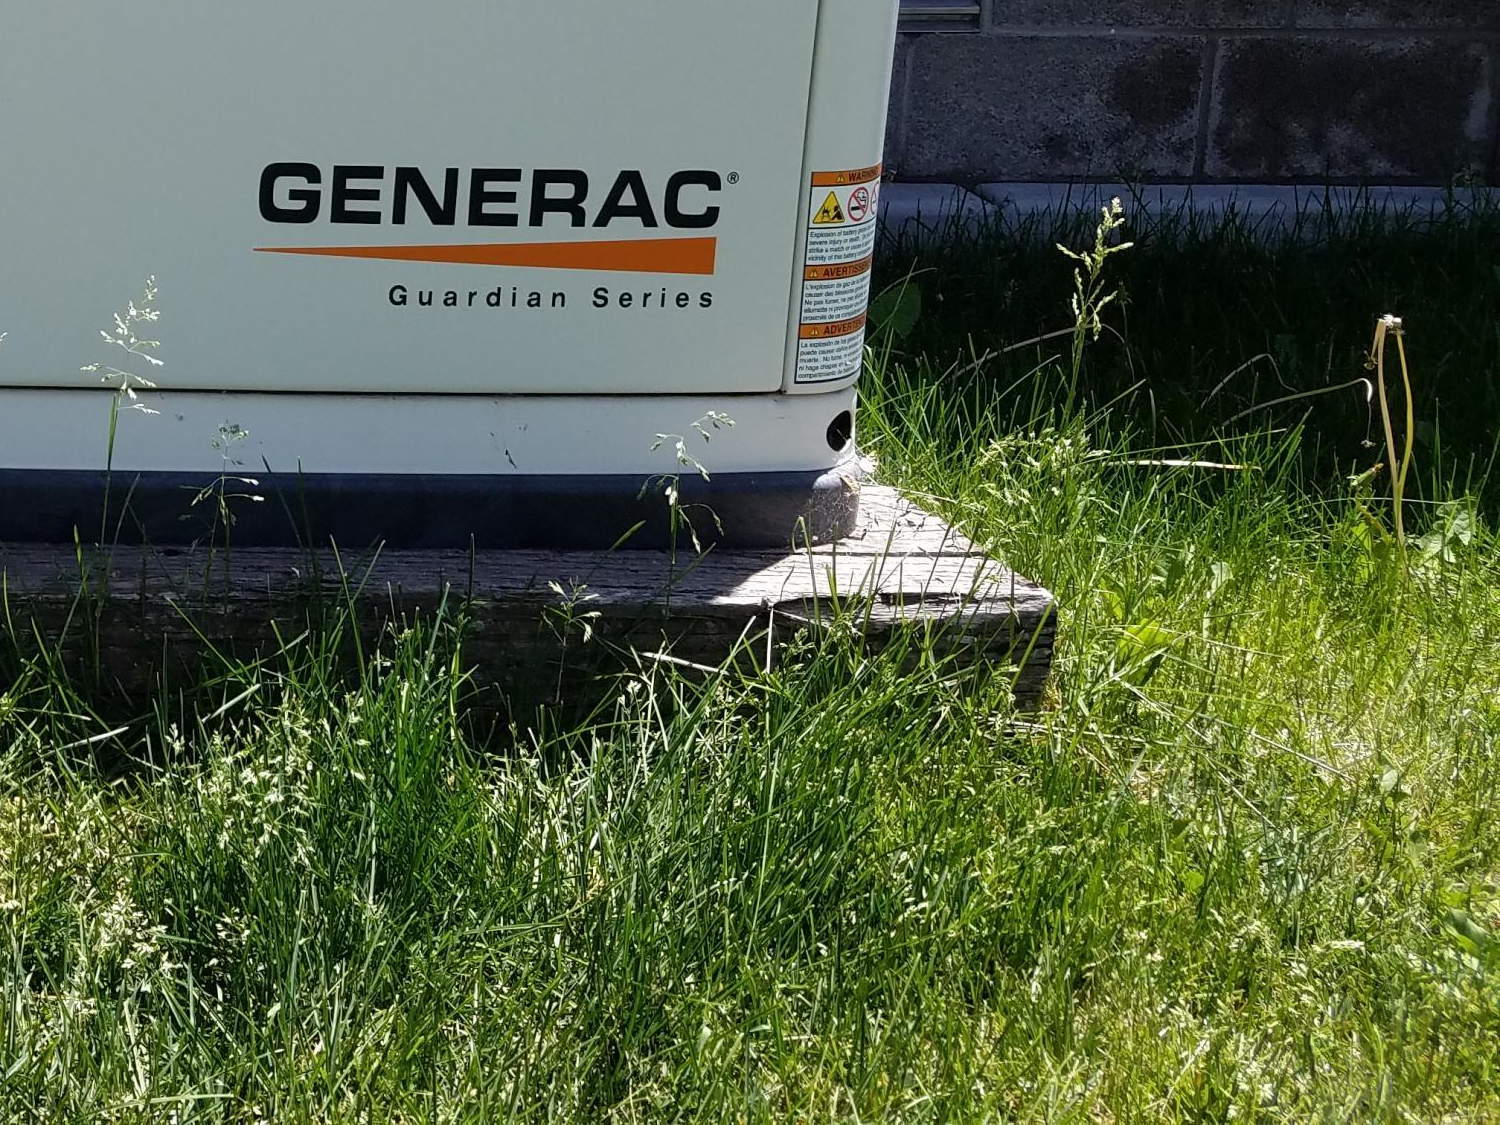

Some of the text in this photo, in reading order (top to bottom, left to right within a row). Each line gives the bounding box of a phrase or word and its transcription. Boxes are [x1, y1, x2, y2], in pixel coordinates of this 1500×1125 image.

[848, 166, 879, 182] WARN
[258, 162, 722, 229] GENERAC
[388, 284, 713, 308] Guardian Series
